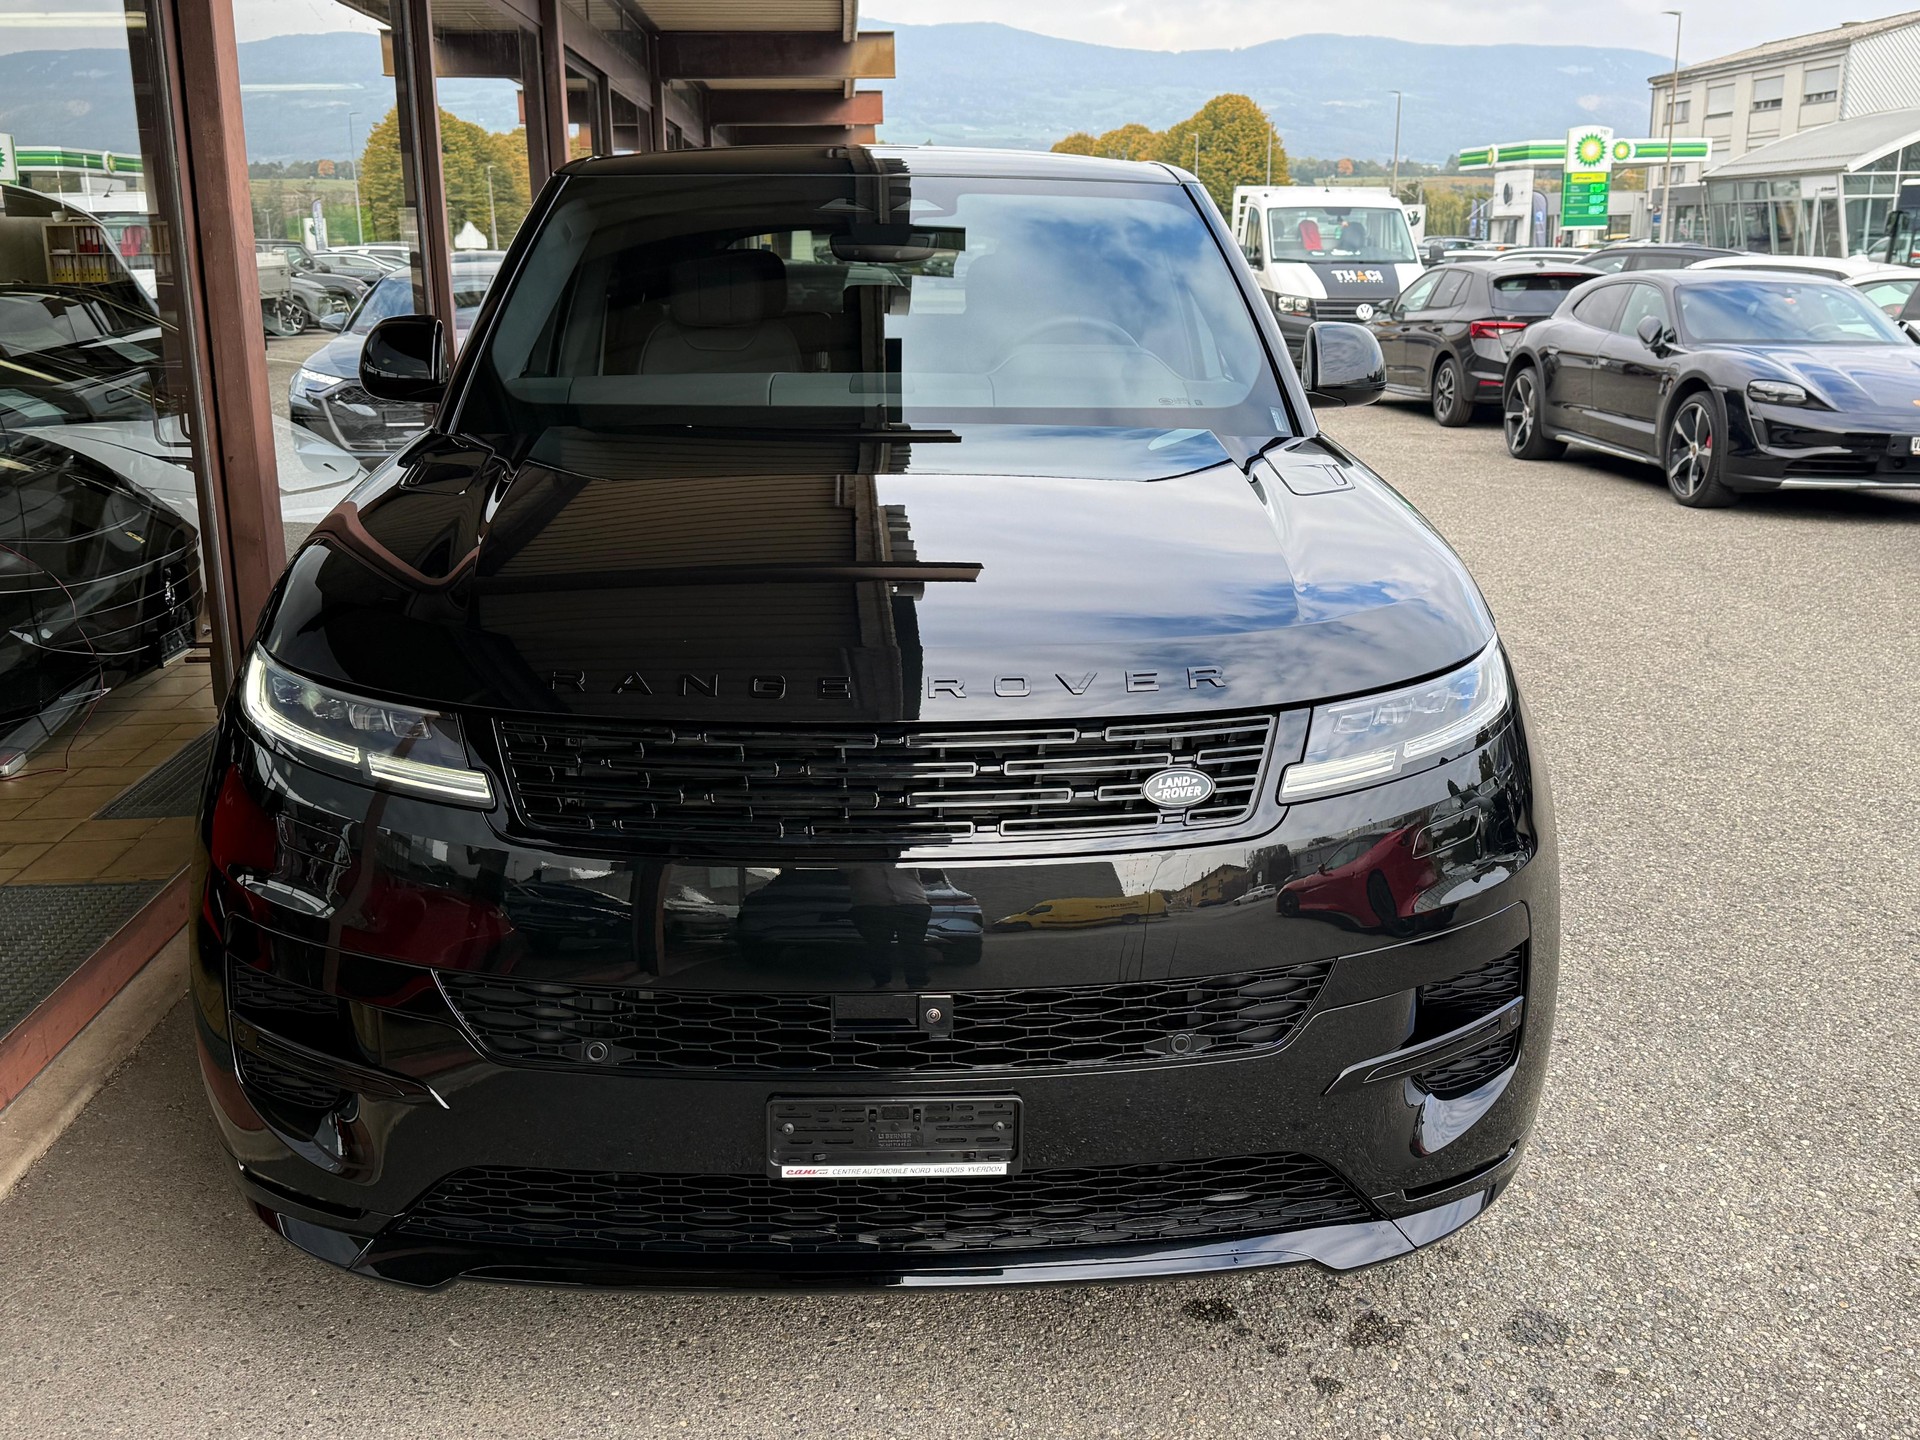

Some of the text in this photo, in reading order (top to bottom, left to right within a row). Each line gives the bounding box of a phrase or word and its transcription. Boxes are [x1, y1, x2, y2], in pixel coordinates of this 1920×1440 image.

[548, 666, 1226, 701] RANGE ROVER
[1158, 776, 1190, 789] LAND
[1162, 786, 1202, 800] ROVER
[967, 1165, 1003, 1173] YVERDON
